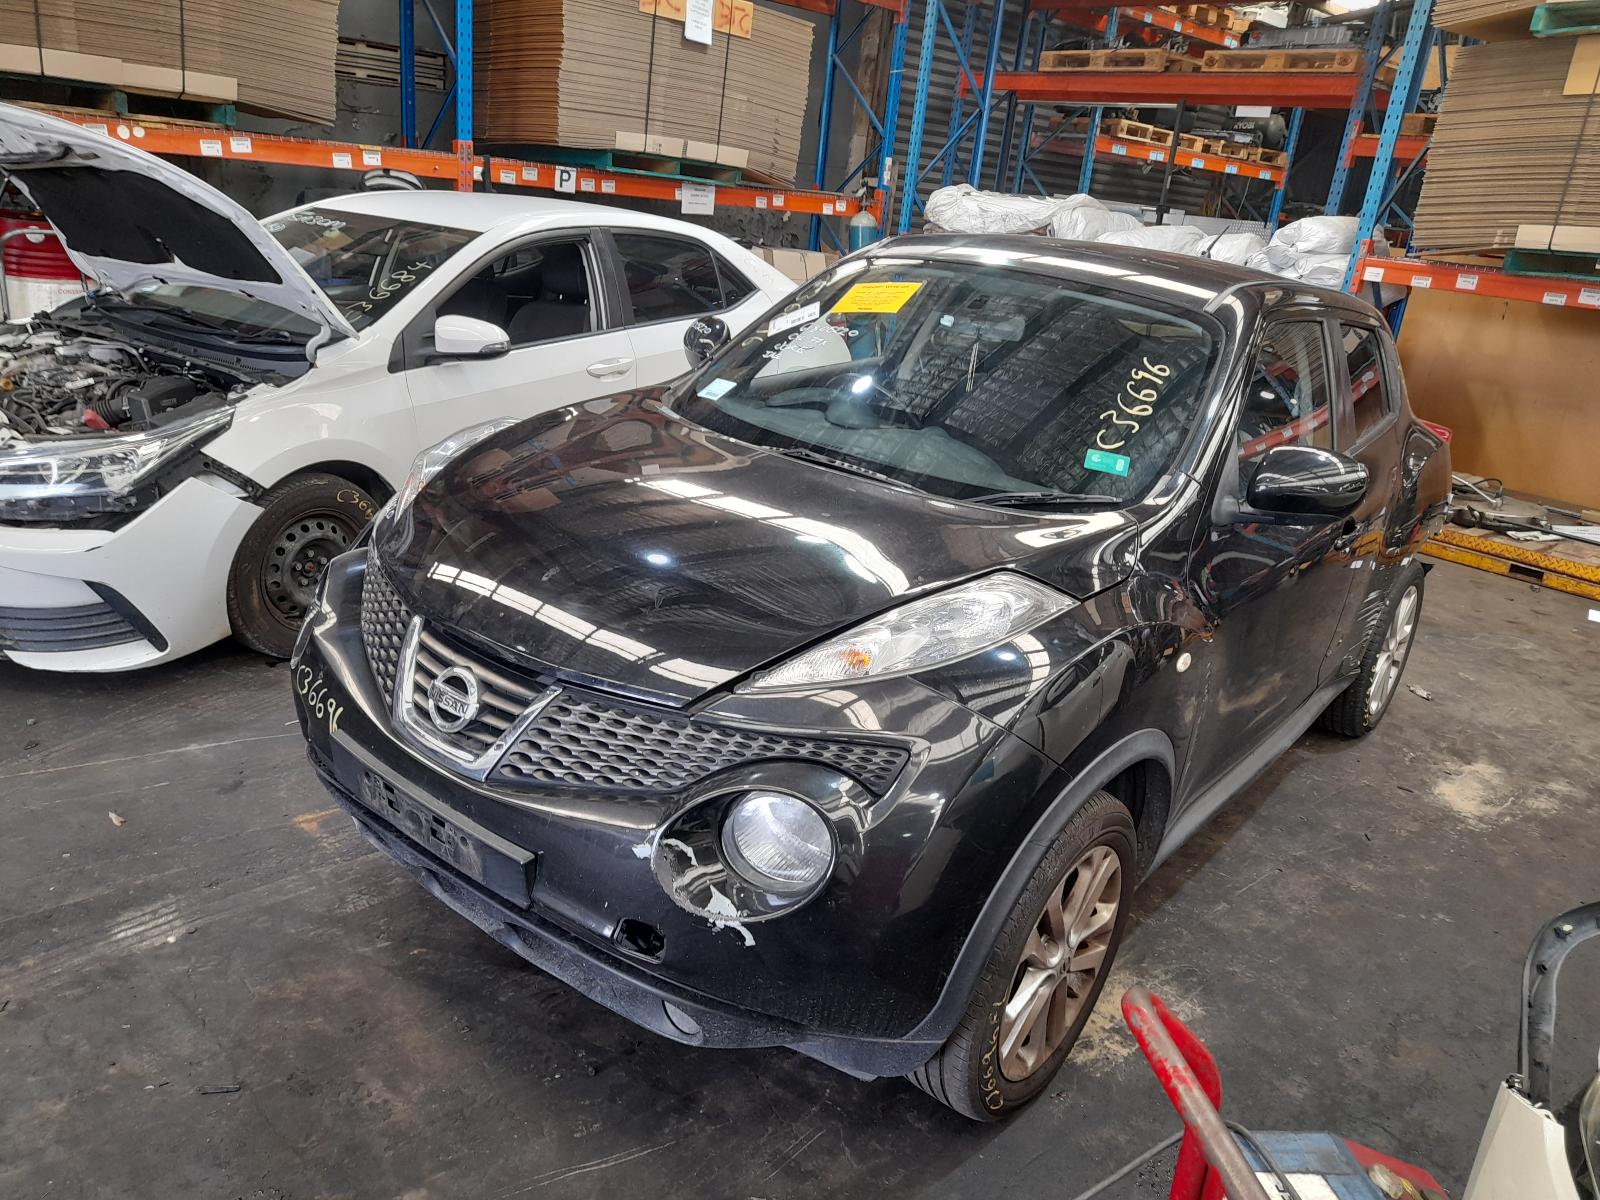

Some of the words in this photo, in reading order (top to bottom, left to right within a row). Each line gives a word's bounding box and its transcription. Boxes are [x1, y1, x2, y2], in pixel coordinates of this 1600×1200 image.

[559, 169, 572, 188] P
[1096, 356, 1171, 450] C36696
[429, 686, 470, 715] NISSAN
